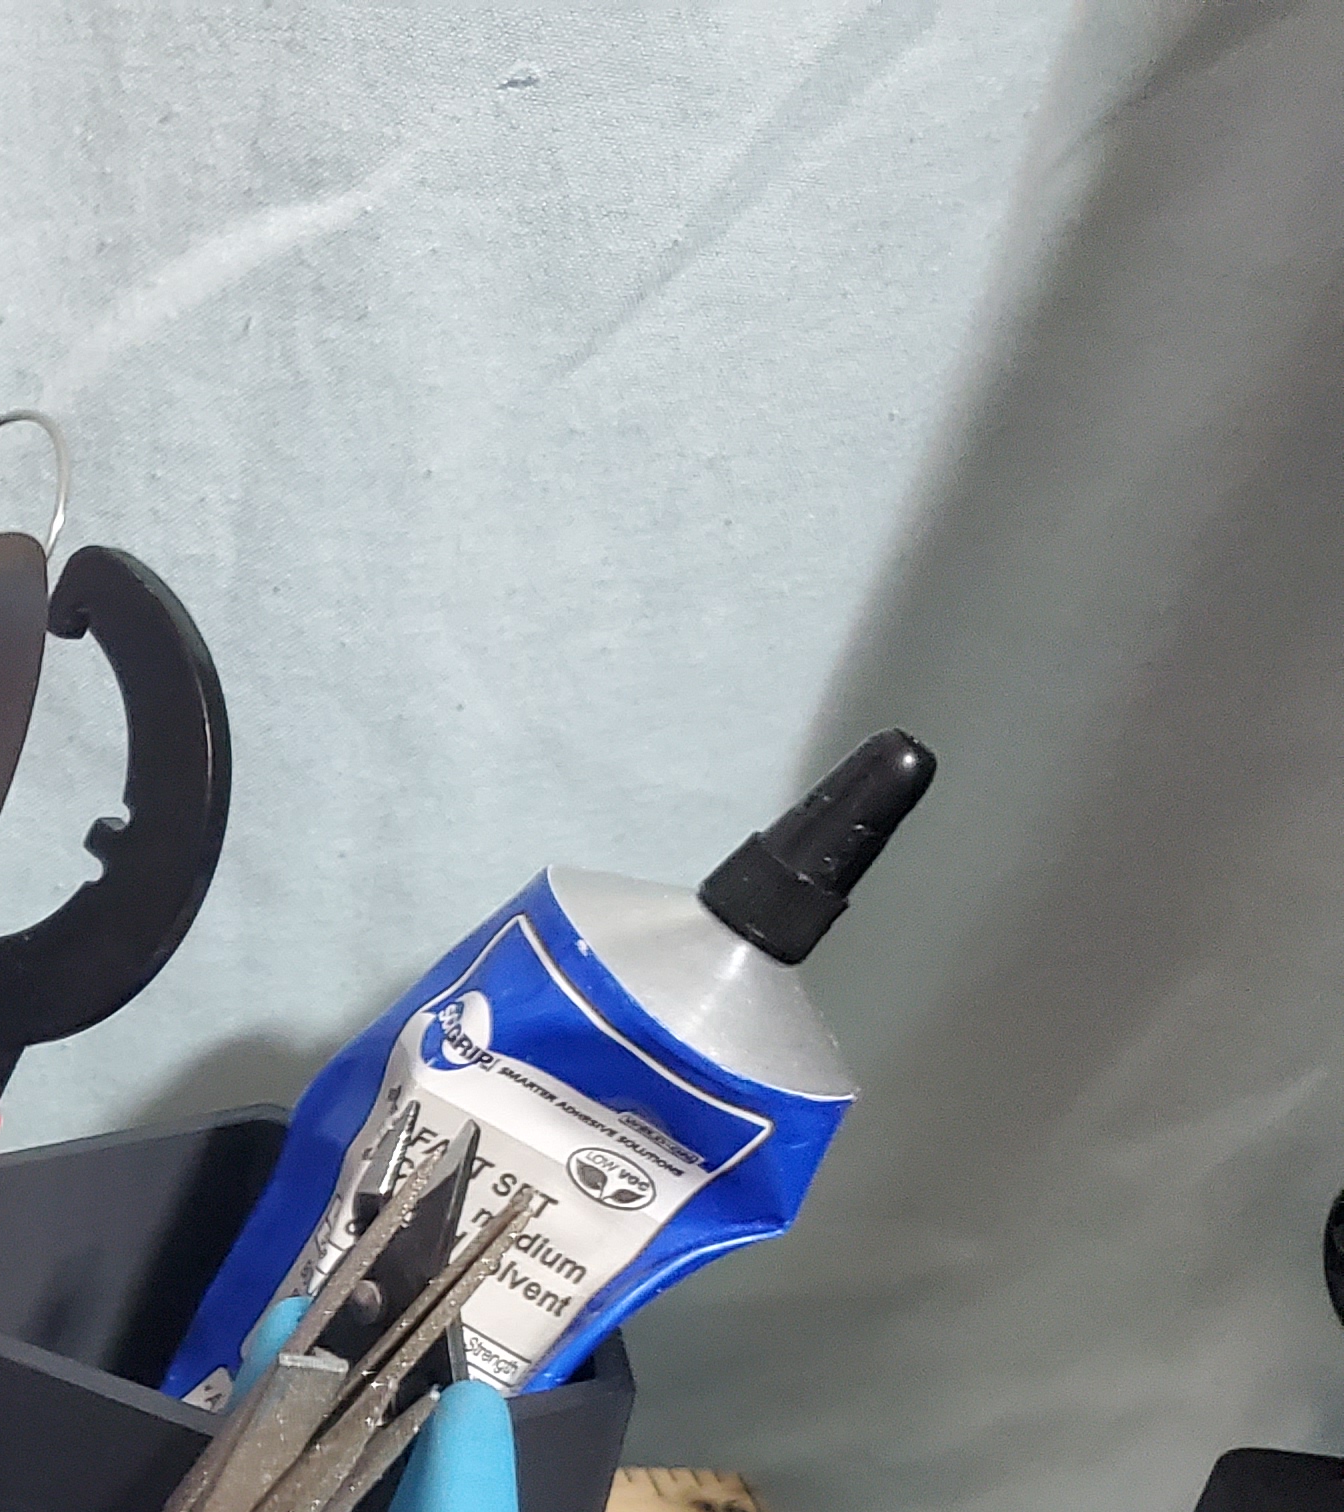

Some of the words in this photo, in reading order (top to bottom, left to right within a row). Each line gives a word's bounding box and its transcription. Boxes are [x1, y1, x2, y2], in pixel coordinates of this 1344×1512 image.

[497, 1066, 558, 1103] SMARTER
[555, 1101, 619, 1138] ADHESIVE
[617, 1135, 685, 1177] SOLUTIONS
[411, 1126, 496, 1181] FAT
[491, 1172, 559, 1219] ST
[586, 1151, 618, 1173] LOW
[618, 1168, 651, 1192] VOC
[471, 1207, 587, 1285] mdium
